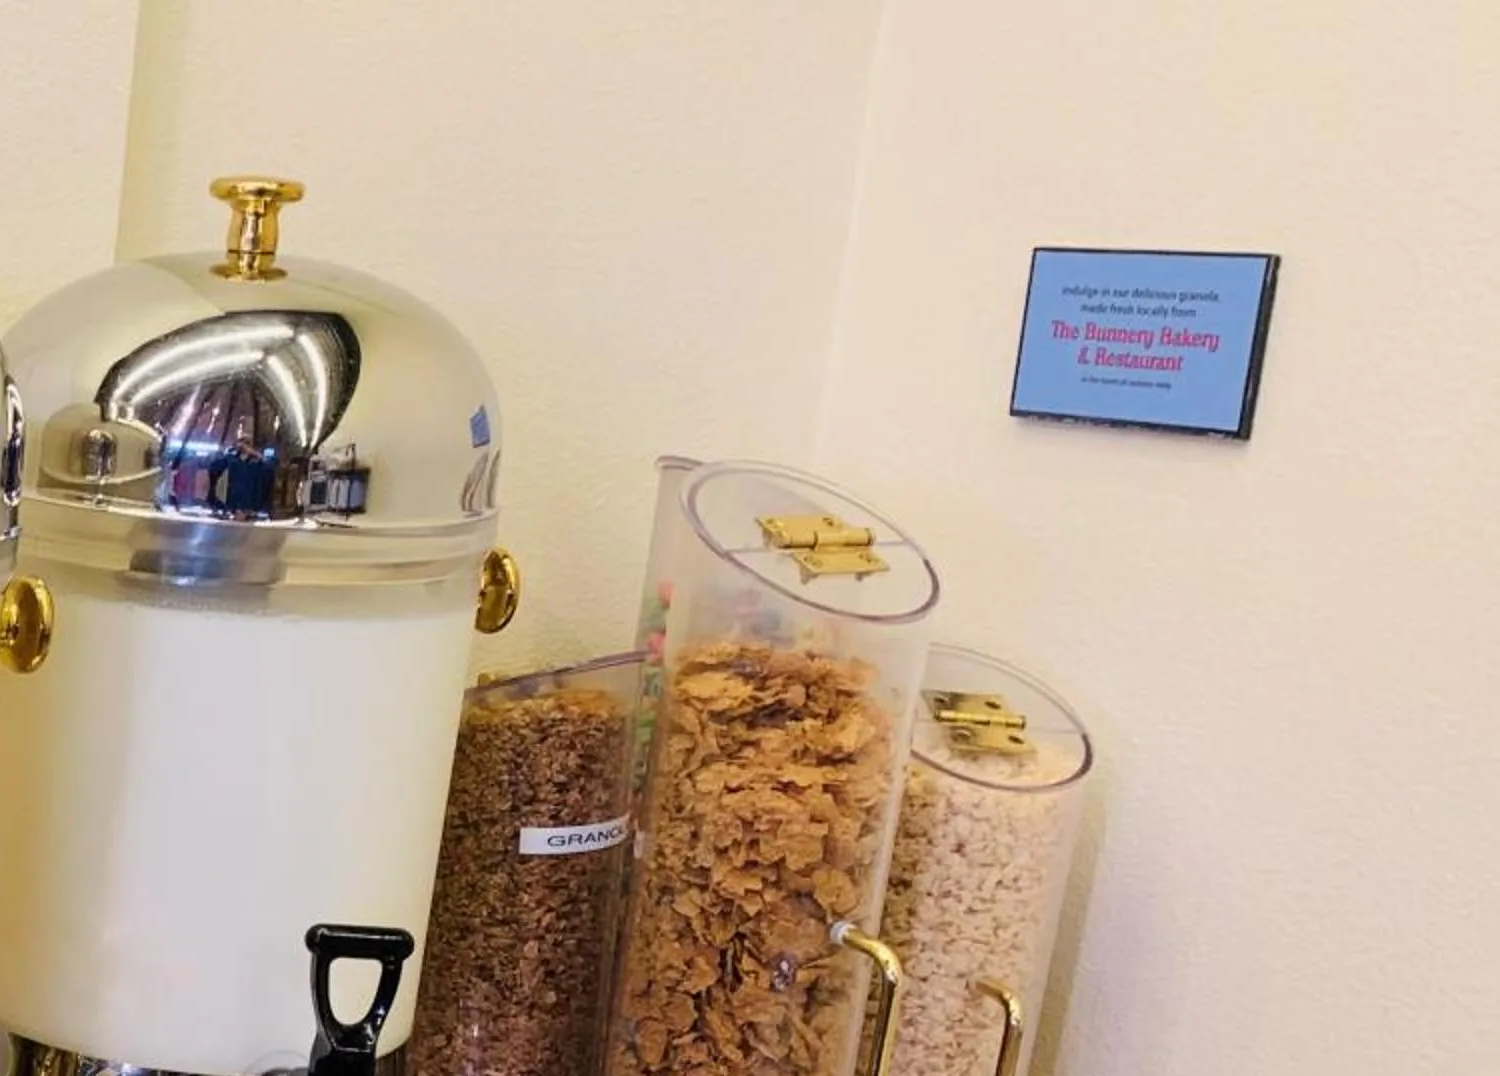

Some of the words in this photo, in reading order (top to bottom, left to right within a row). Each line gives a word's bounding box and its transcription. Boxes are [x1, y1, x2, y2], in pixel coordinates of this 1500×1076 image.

[1052, 319, 1080, 340] The
[1084, 321, 1156, 350] Bunnery
[1159, 325, 1221, 352] Bakery
[1076, 345, 1090, 365] &
[1094, 346, 1185, 372] Restaurant
